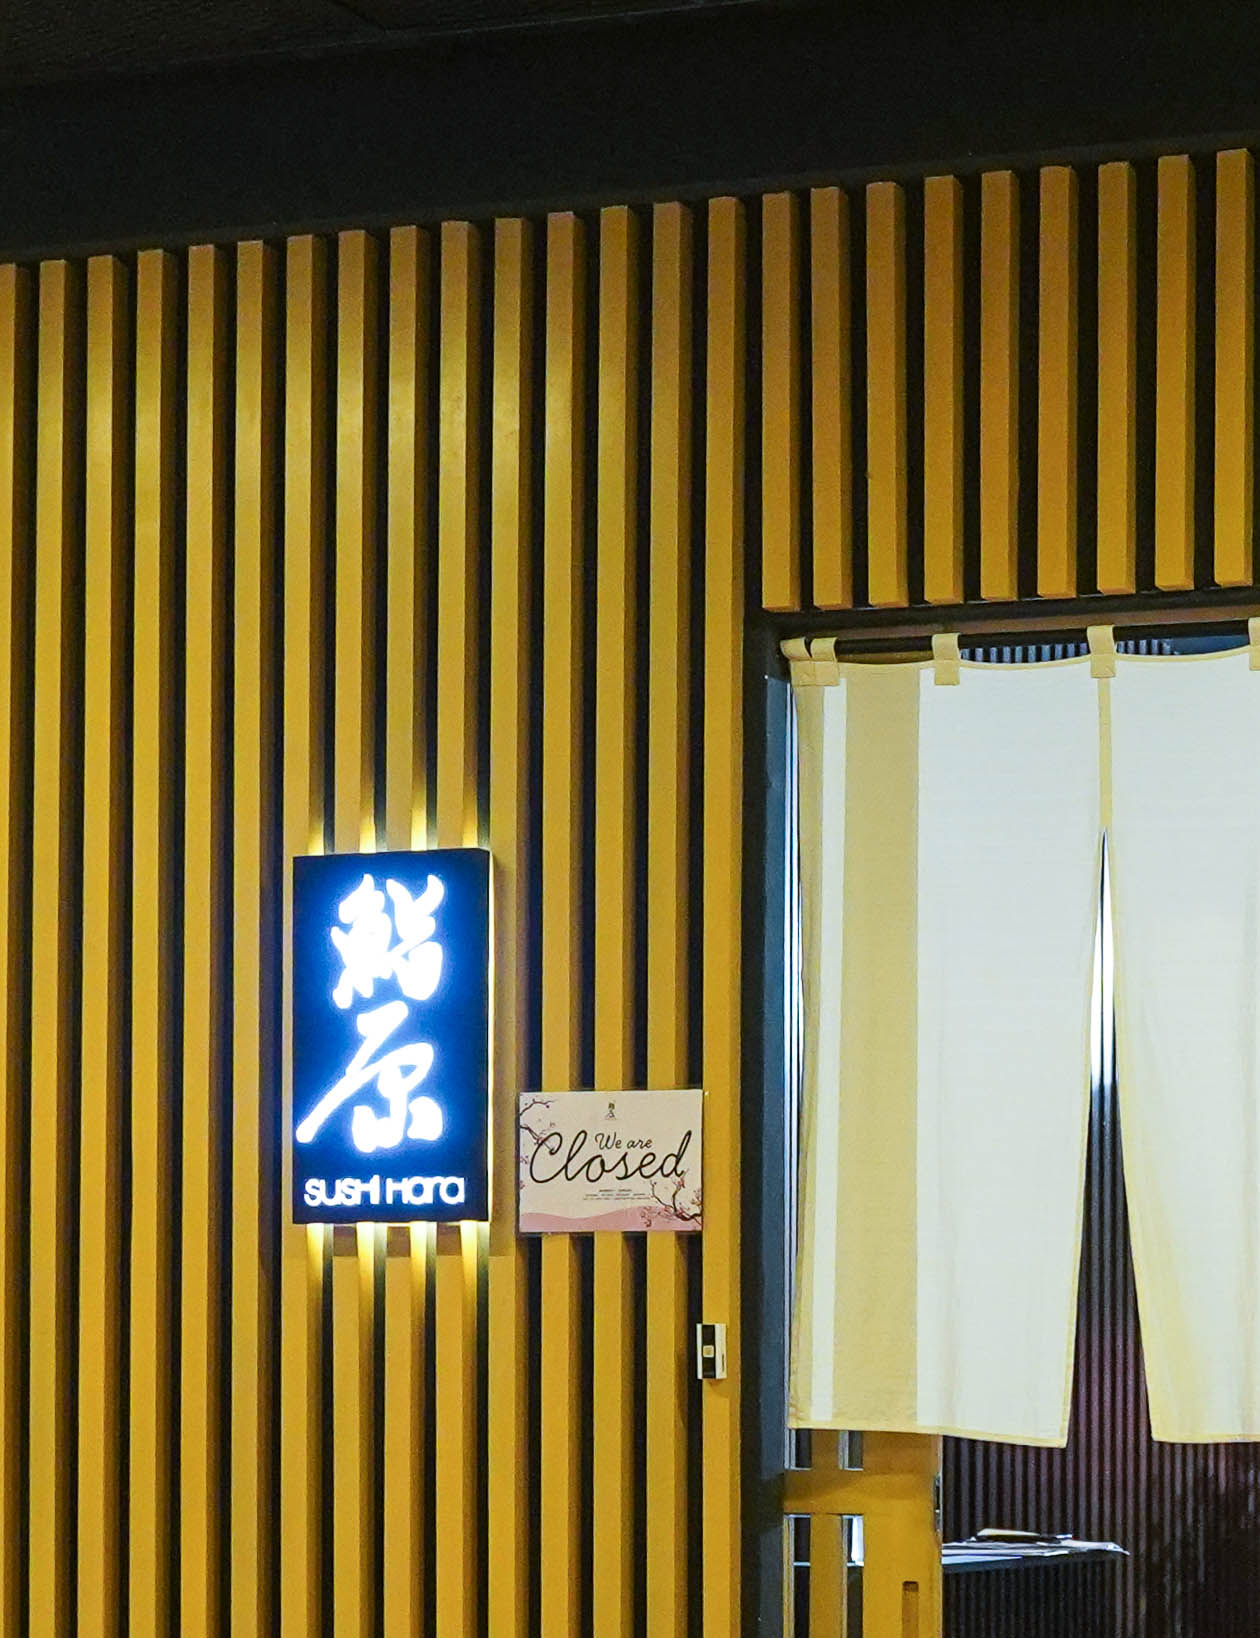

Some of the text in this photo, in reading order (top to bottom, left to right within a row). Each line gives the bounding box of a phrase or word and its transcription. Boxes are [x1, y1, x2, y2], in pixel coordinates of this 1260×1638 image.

[529, 1129, 692, 1184] Closed
[594, 1132, 653, 1150] We are
